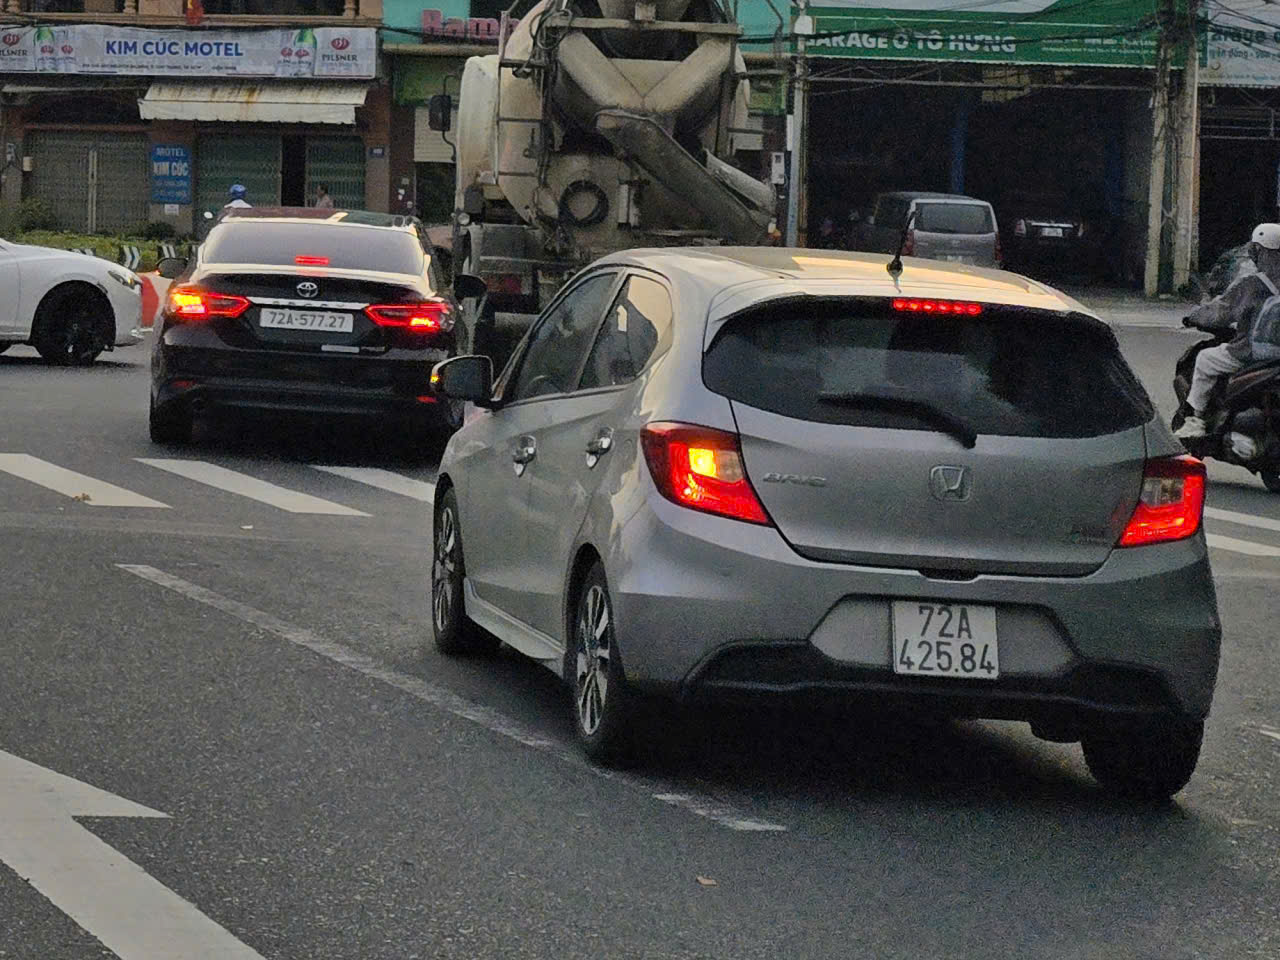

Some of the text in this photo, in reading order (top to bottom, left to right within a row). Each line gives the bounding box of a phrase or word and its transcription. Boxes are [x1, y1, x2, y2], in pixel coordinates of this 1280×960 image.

[106, 38, 243, 57] KIM CÚC MOTEL
[322, 54, 357, 62] PILSNER
[269, 311, 345, 328] 72A-577.27
[919, 605, 972, 639] 72A
[900, 639, 995, 674] 425.84
